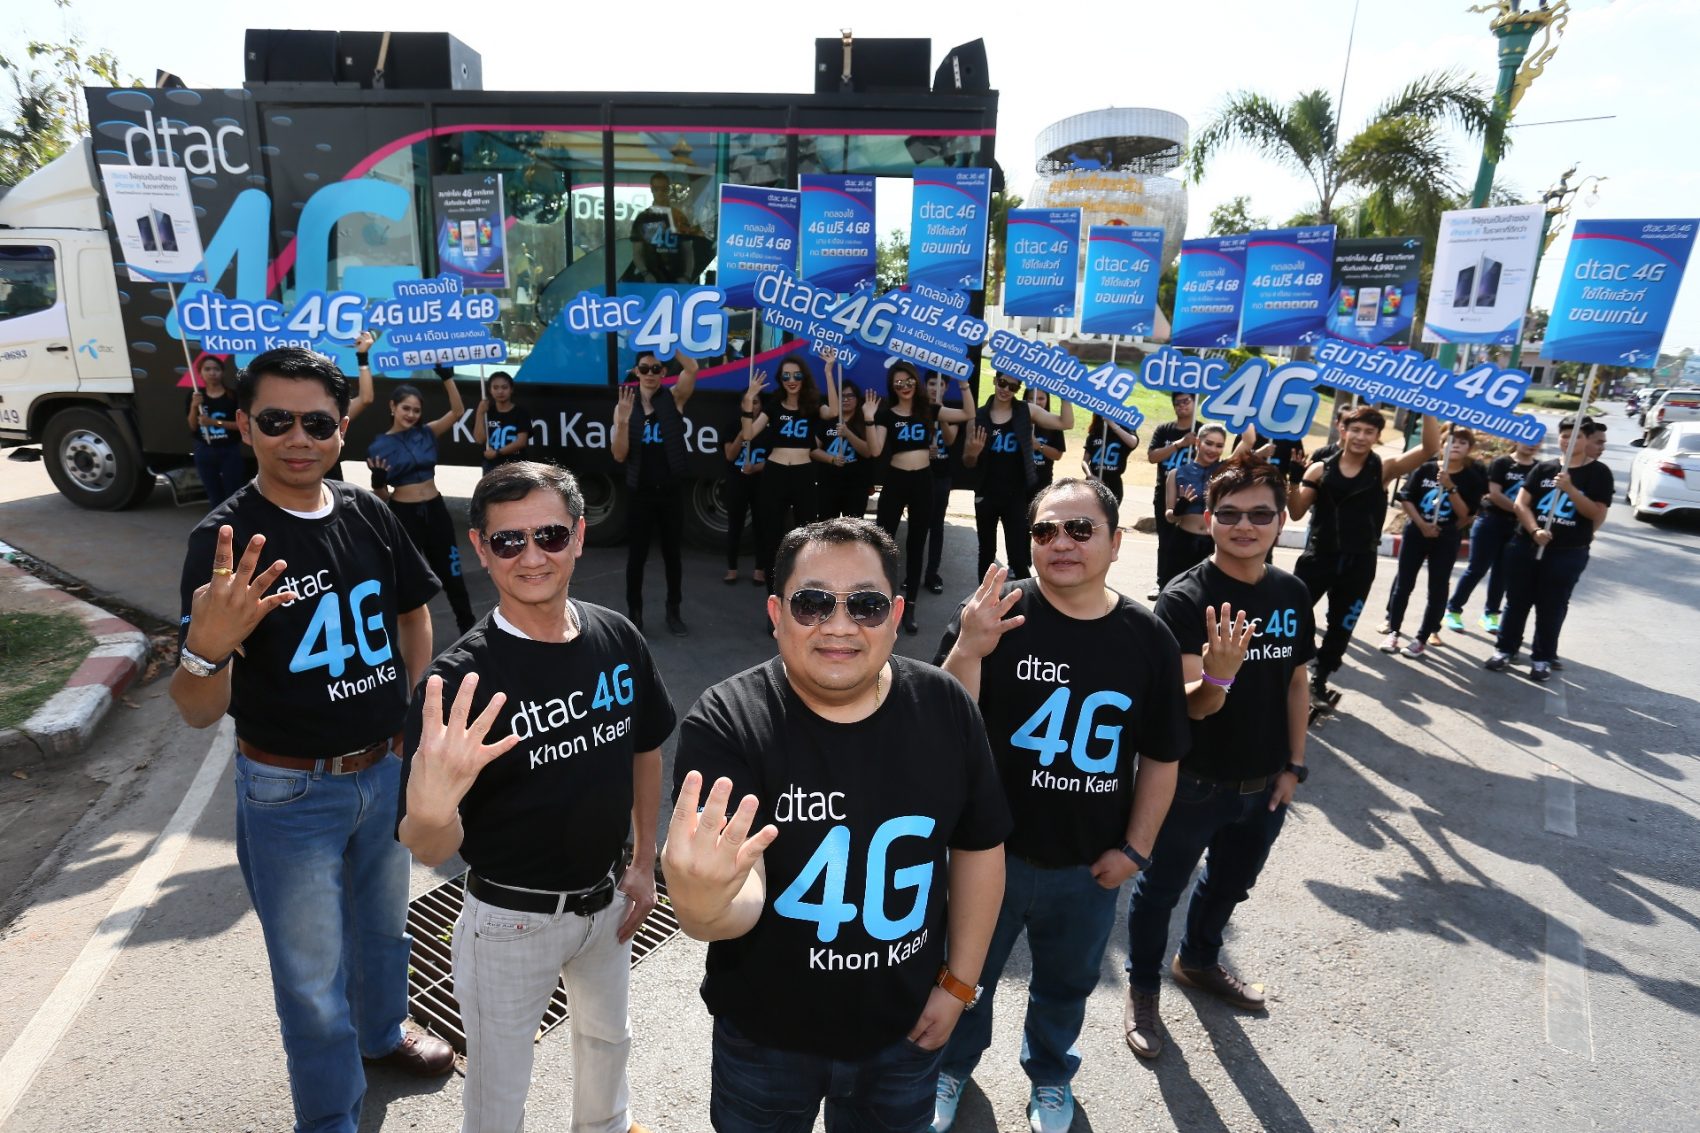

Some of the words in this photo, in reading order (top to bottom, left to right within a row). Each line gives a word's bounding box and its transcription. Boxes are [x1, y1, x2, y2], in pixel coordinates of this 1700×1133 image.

[125, 110, 250, 175] dtac
[920, 201, 954, 219] dtac
[956, 204, 976, 219] 4G
[808, 222, 825, 233] 4G
[827, 221, 844, 233] ฟรี
[846, 222, 854, 233] 4
[855, 222, 870, 234] GB
[726, 234, 743, 246] 4G
[745, 235, 764, 248] ฟรี
[765, 237, 774, 248] 4
[775, 238, 791, 250] GB
[921, 240, 971, 255] ขอนแก่น
[1014, 238, 1047, 254] dtac
[1050, 240, 1068, 254] 4G
[1094, 255, 1128, 272] dtac
[1130, 259, 1150, 272] 4G
[1369, 253, 1383, 263] 4G
[1574, 258, 1631, 280] dtac
[1632, 263, 1667, 281] 4G
[166, 179, 421, 377] 4G
[398, 277, 458, 296] ทดลองใช้
[1016, 272, 1065, 286] ขอนแก่น
[1183, 281, 1197, 292] 4G
[1198, 280, 1215, 292] ฟรี
[1215, 280, 1223, 291] 4
[1224, 280, 1240, 292] GB
[1252, 275, 1271, 287] 4G
[1272, 273, 1293, 287] ฟรี
[1294, 274, 1304, 285] 4
[1305, 273, 1324, 286] GB
[915, 283, 966, 310] ทดลองใช้
[1095, 291, 1144, 304] ขอนแก่น
[1581, 286, 1648, 302] ใช้ได้แล้วที่
[183, 294, 280, 332] dtac
[287, 295, 364, 340] 4G
[369, 304, 404, 326] 4G
[408, 299, 442, 324] ฟรี
[447, 300, 463, 320] 4
[466, 298, 494, 319] GB
[758, 270, 832, 319] dtac
[831, 295, 898, 346] 4G
[1568, 306, 1649, 324] ขอนแก่น
[569, 296, 641, 330] dtac
[634, 290, 723, 354] 4G
[765, 308, 803, 332] Khon
[808, 320, 843, 344] Kaen
[911, 304, 944, 327] ฟรี
[942, 315, 957, 332] 4
[957, 320, 985, 341] GB
[205, 335, 257, 351] Khon
[264, 336, 312, 350] Kaen
[392, 334, 413, 344] นาน
[415, 333, 422, 342] 4
[424, 330, 449, 341] เดือน
[907, 327, 913, 336] 4
[914, 329, 935, 343] เดือน
[379, 356, 400, 368] กด
[993, 333, 1084, 382] สมาร์ทโฟน
[1087, 366, 1134, 400] 4G
[1319, 342, 1449, 391] สมาร์ทโฟน
[1454, 366, 1525, 408] 4G
[1145, 350, 1225, 391] dtac
[1207, 364, 1318, 434] 4G
[489, 425, 518, 449] 4G
[780, 419, 808, 438] 4G
[826, 428, 838, 436] dta
[898, 424, 925, 441] 4G
[992, 432, 1018, 452] 4G
[1092, 442, 1121, 466] 4G
[1536, 487, 1576, 519] 4G
[276, 569, 333, 607] dtac
[289, 579, 392, 678] 4G
[1265, 608, 1297, 638] 4G
[1263, 643, 1293, 660] Kaen
[1016, 654, 1070, 684] dtac
[327, 670, 376, 702] Khon
[510, 690, 588, 742] dtac
[591, 663, 634, 712] 4G
[1010, 686, 1133, 774] 4G
[529, 735, 588, 770] Khon
[592, 716, 631, 747] Kaen
[1030, 769, 1080, 792] Khon
[1085, 775, 1118, 793] Kaen
[775, 783, 847, 823] dtac
[773, 815, 936, 943] 4G
[809, 947, 879, 971] Khon
[887, 928, 928, 967] Kaen
